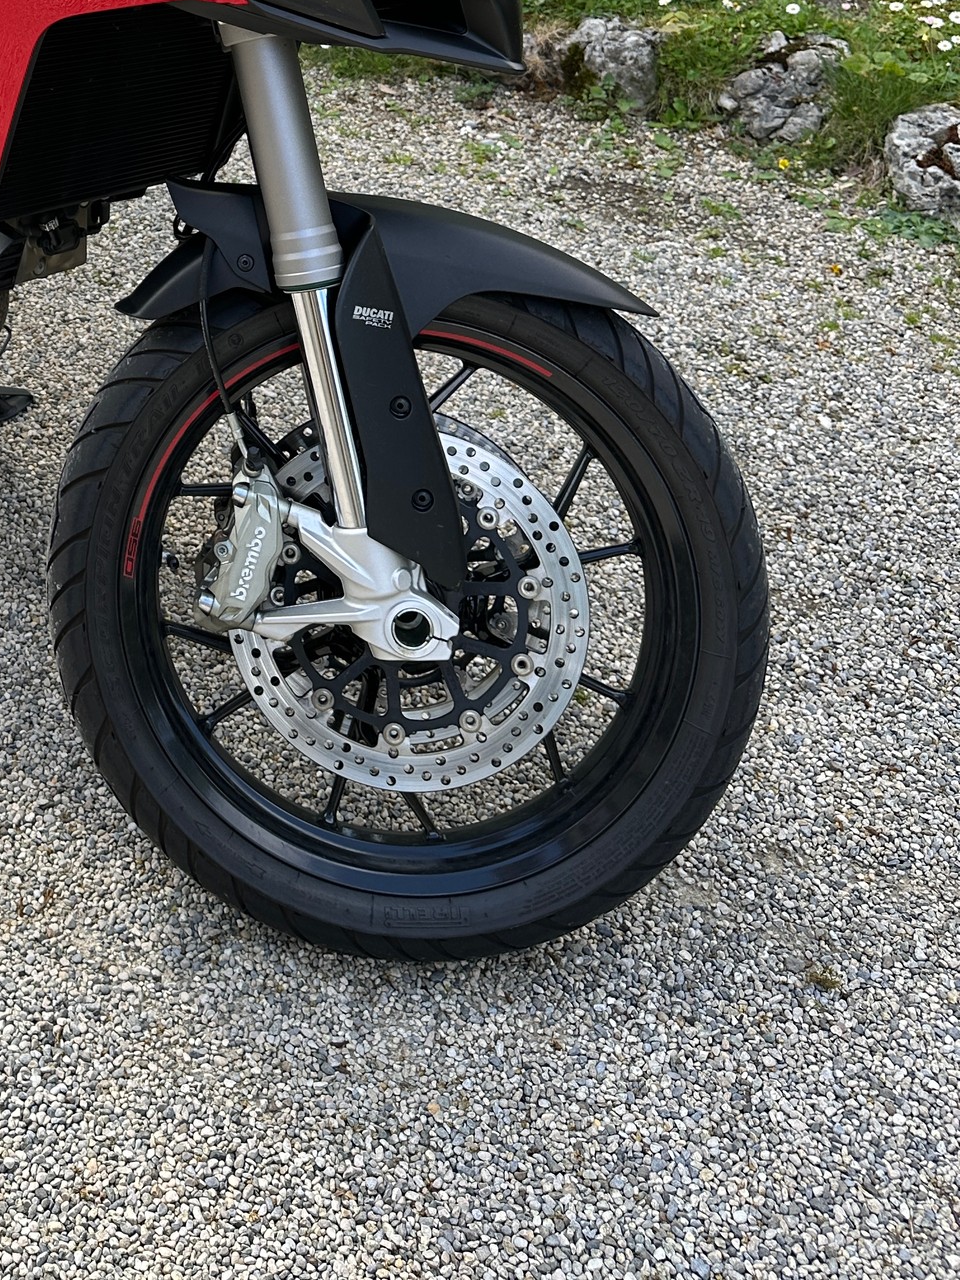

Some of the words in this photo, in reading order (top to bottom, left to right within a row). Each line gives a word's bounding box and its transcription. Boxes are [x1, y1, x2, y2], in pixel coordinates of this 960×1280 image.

[353, 305, 394, 321] DUCATI
[365, 320, 392, 329] PACK
[123, 517, 142, 579] 950
[230, 526, 267, 602] brembo
